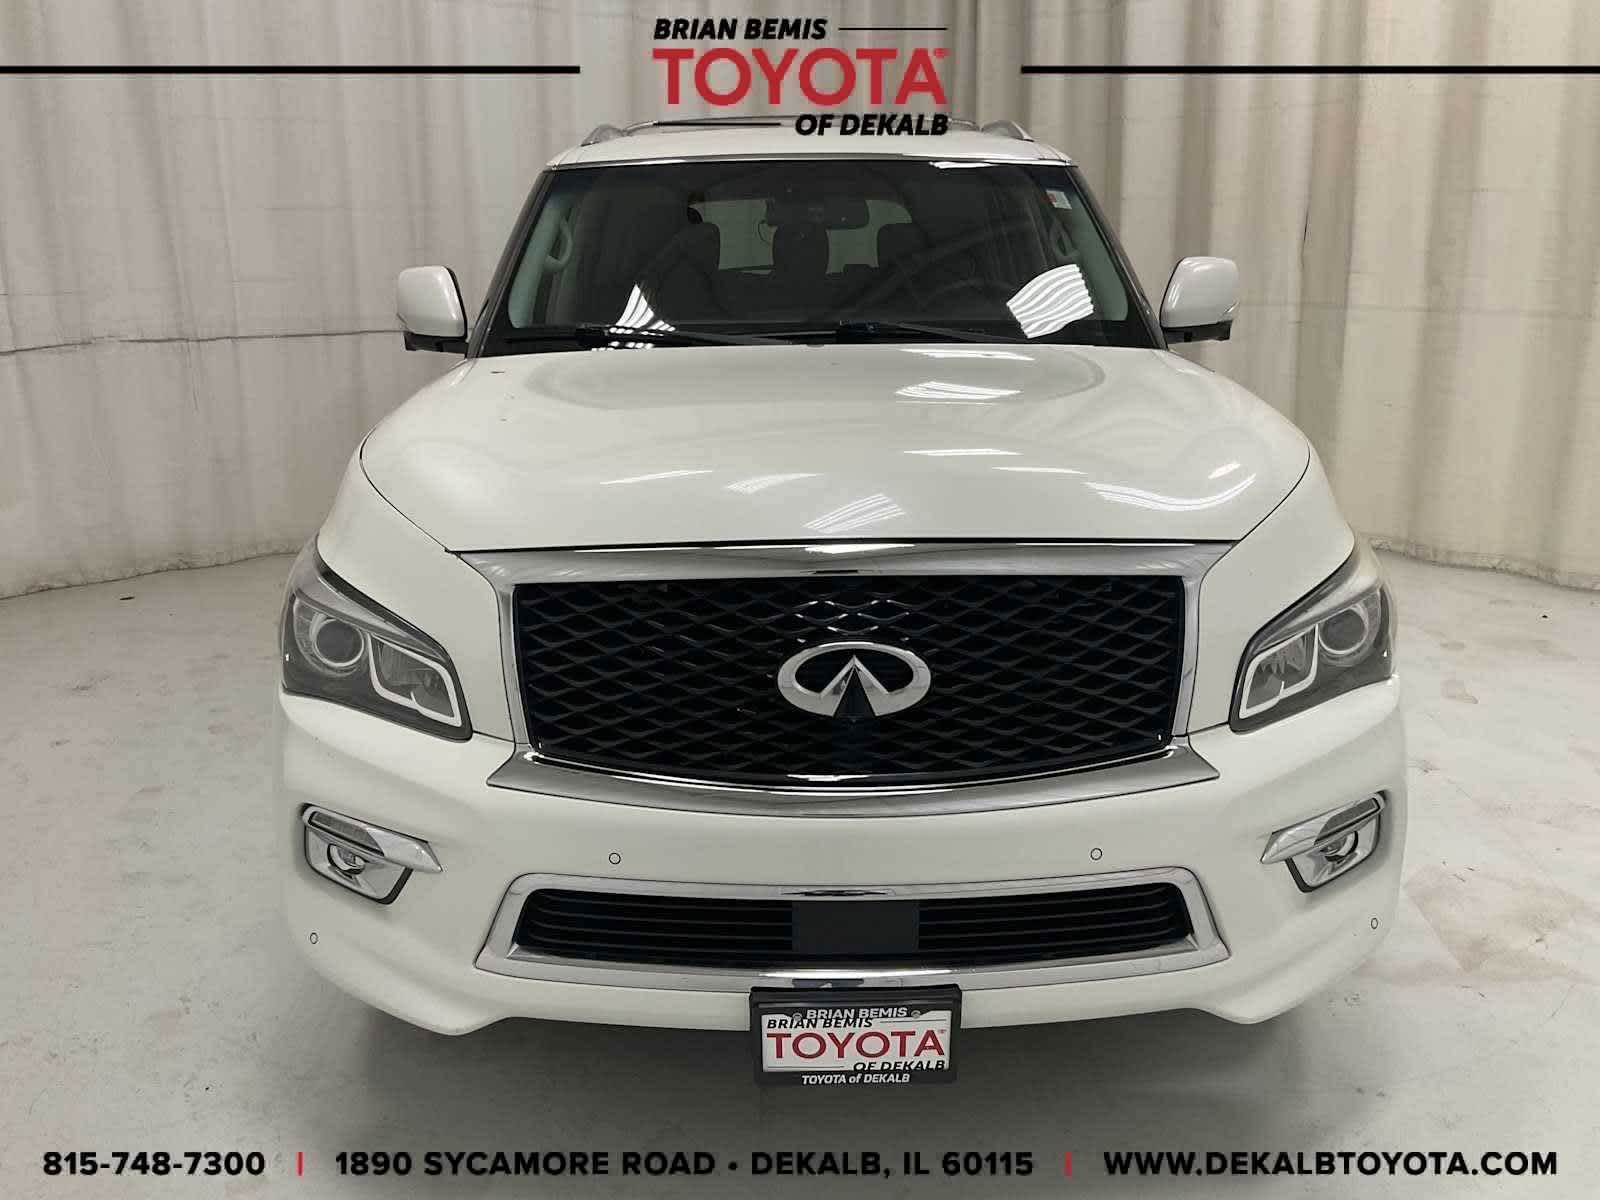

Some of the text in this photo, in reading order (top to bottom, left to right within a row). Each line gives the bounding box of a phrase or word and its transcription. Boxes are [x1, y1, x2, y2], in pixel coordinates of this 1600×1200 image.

[806, 1007, 908, 1020] BRIAN BEMIS
[767, 1018, 873, 1029] BRIAN BEMIS
[766, 1029, 945, 1059] TOYOTA
[853, 1059, 945, 1071] OF DEKALB
[802, 1073, 910, 1085] TOYOTA of DEKALB
